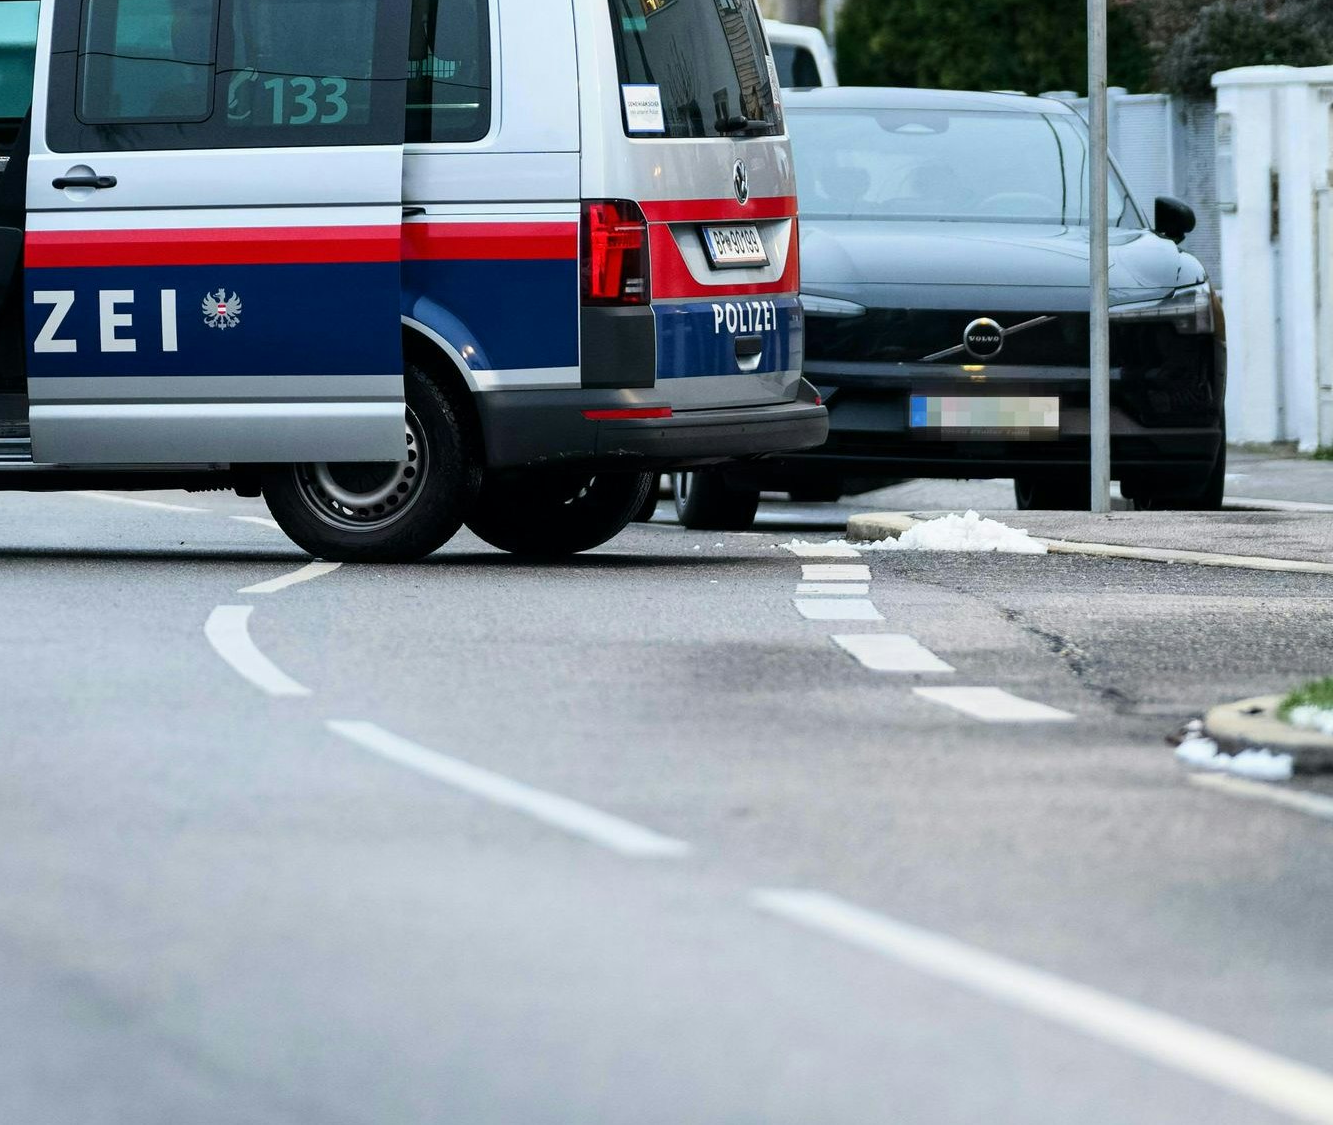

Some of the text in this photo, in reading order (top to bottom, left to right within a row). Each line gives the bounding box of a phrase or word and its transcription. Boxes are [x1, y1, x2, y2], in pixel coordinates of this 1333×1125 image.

[263, 75, 349, 125] 133
[711, 300, 777, 335] POLIZEI
[968, 335, 1000, 343] VOLVO
